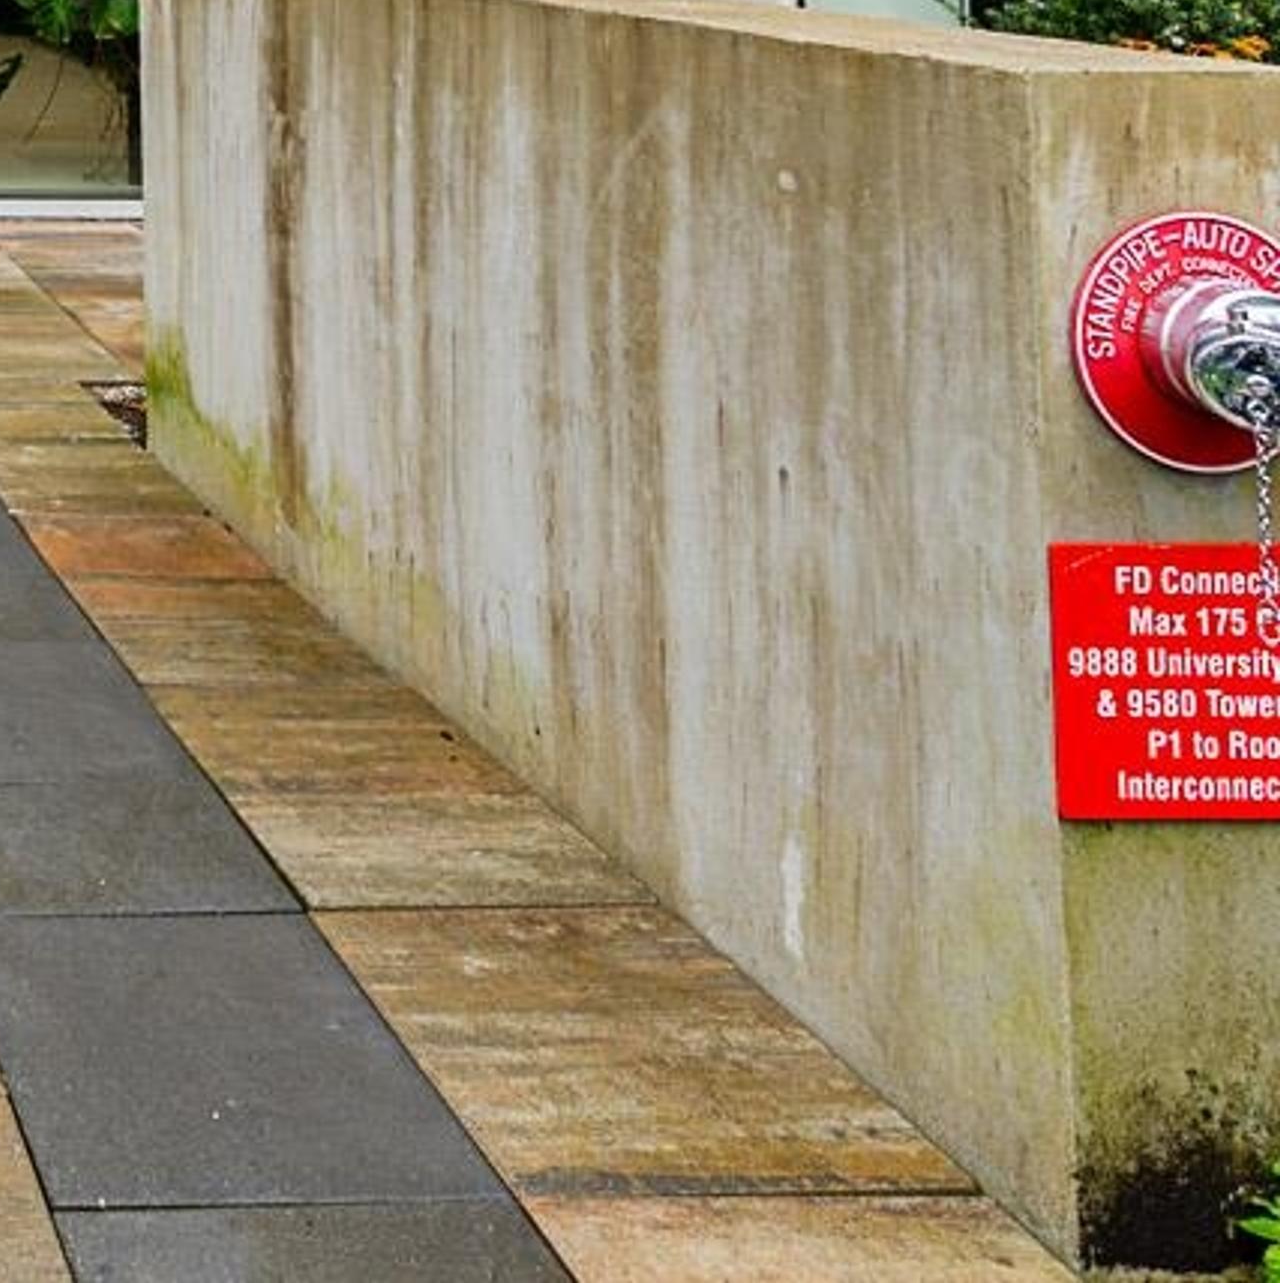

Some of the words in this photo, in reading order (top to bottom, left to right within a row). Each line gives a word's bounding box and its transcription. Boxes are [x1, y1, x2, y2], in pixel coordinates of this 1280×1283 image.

[1114, 565, 1152, 594] FD
[1129, 606, 1187, 636] Max
[1196, 607, 1247, 637] 175
[1068, 647, 1137, 677] 9888
[1096, 689, 1117, 718] &
[1126, 689, 1197, 718] 9580
[1147, 729, 1181, 759] P1
[1192, 731, 1220, 759] to
